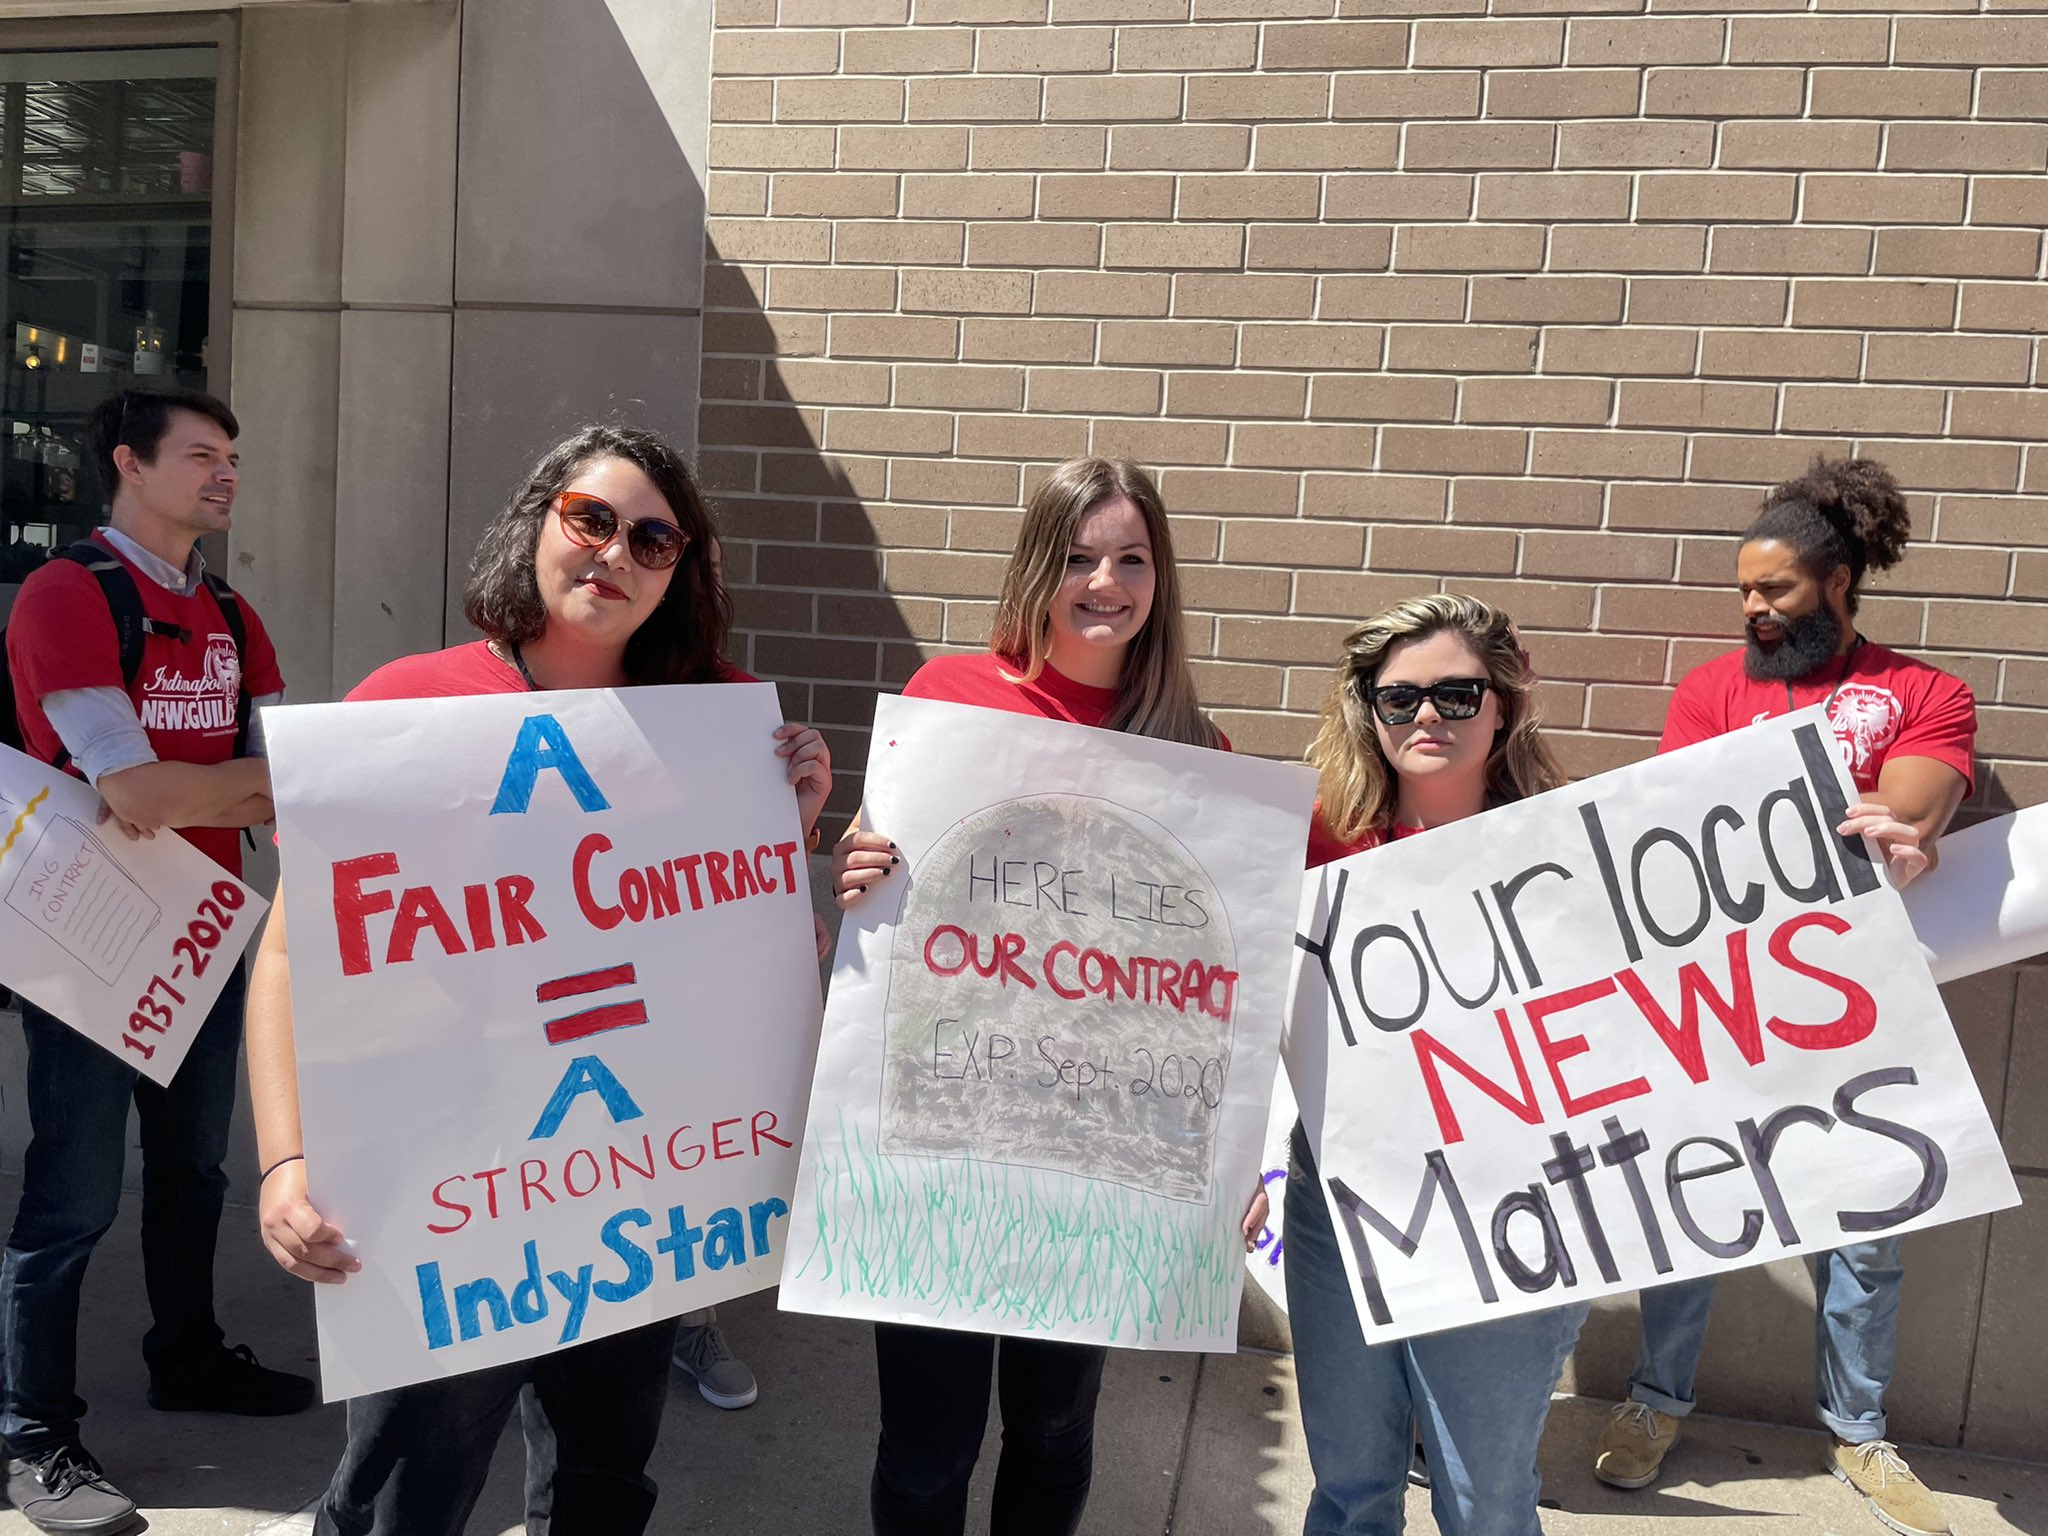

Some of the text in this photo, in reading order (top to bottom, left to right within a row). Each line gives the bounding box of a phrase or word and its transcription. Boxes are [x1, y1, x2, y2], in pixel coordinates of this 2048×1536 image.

[488, 713, 612, 815] A
[29, 860, 59, 901] ING
[43, 841, 95, 922] CONTRACT
[331, 832, 799, 976] FAIR CONTRACT
[969, 854, 1209, 929] HERE LIES
[1294, 723, 1881, 1047] Your local
[123, 879, 246, 1060] 1937-2020
[924, 924, 1239, 1023] OUR CONTRACT
[1038, 1036, 1119, 1100] Sept.
[1130, 1048, 1224, 1109] 2020
[1410, 911, 1878, 1145] NEWS
[527, 1055, 644, 1140] A
[426, 1110, 793, 1234] STRONGER
[1327, 1066, 1948, 1325] Matters
[415, 1197, 788, 1349] IndyStar
